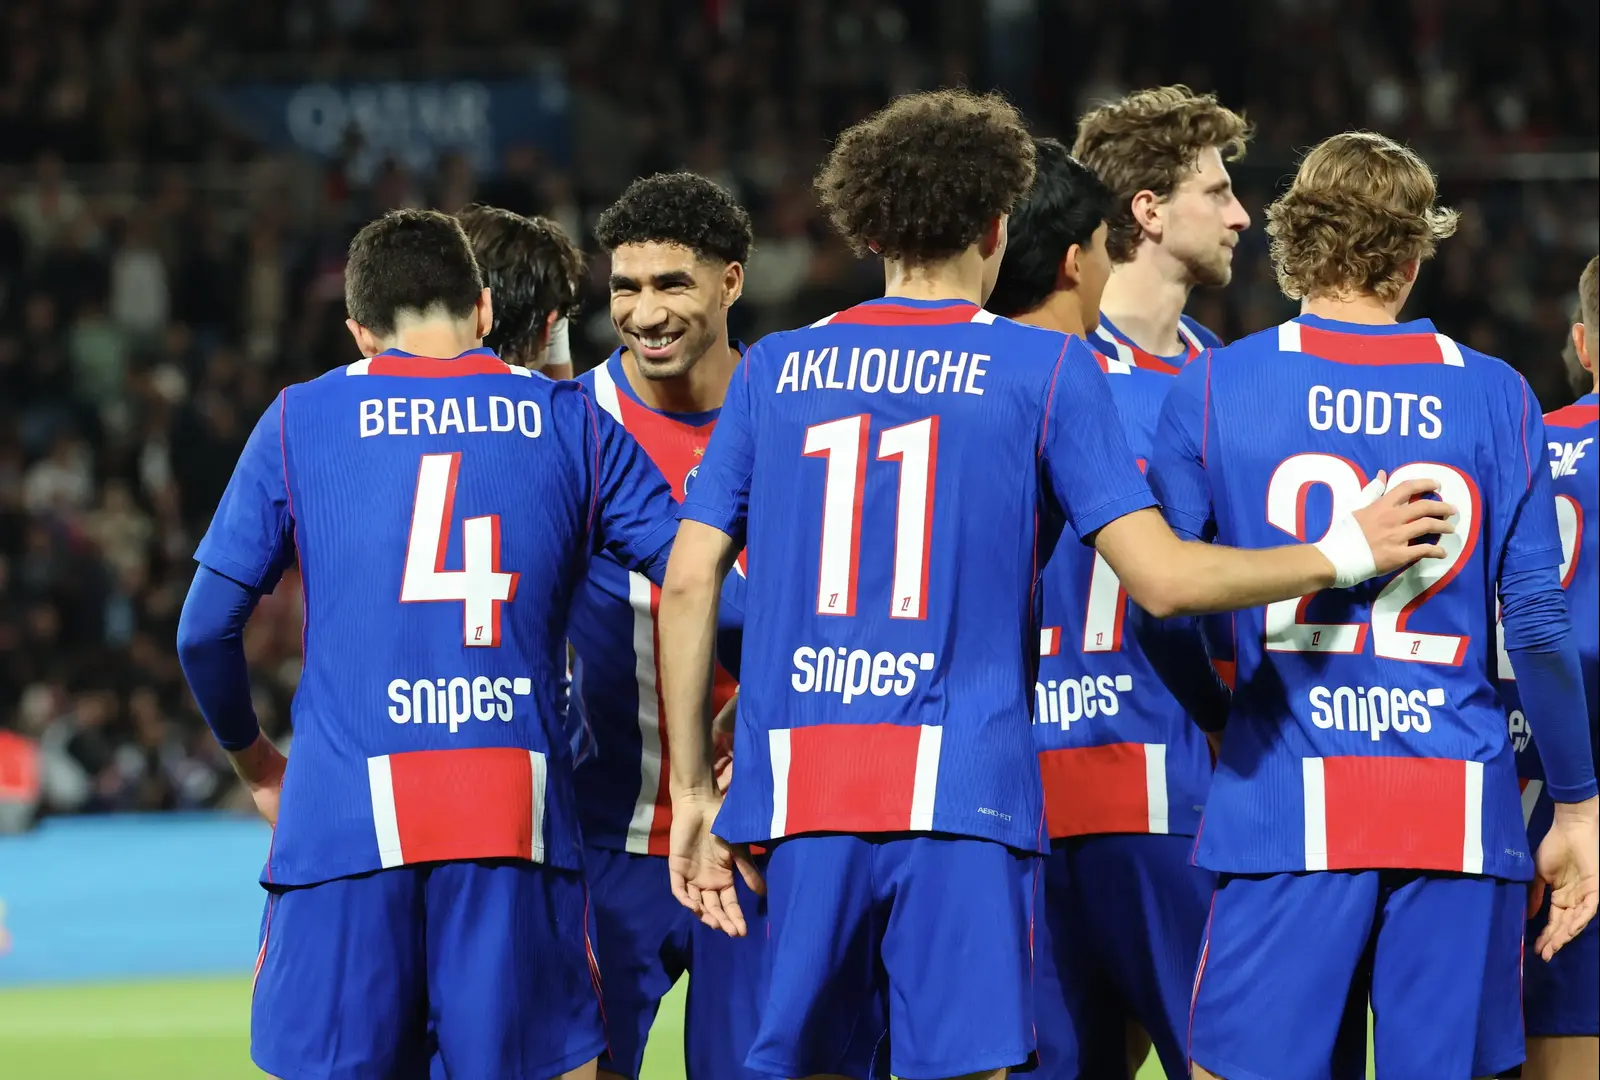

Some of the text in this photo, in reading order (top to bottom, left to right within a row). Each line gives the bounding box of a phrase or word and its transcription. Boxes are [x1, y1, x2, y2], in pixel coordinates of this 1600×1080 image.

[775, 346, 991, 396] AKLIOUCHE
[359, 395, 542, 439] BERALDO
[1308, 384, 1443, 440] GODTS
[801, 413, 941, 621] 11
[399, 451, 521, 648] 4
[1264, 451, 1483, 667] 22
[791, 646, 921, 705] snipes
[1032, 674, 1119, 731] nipes
[388, 676, 514, 734] snipes
[1308, 685, 1432, 742] snipes
